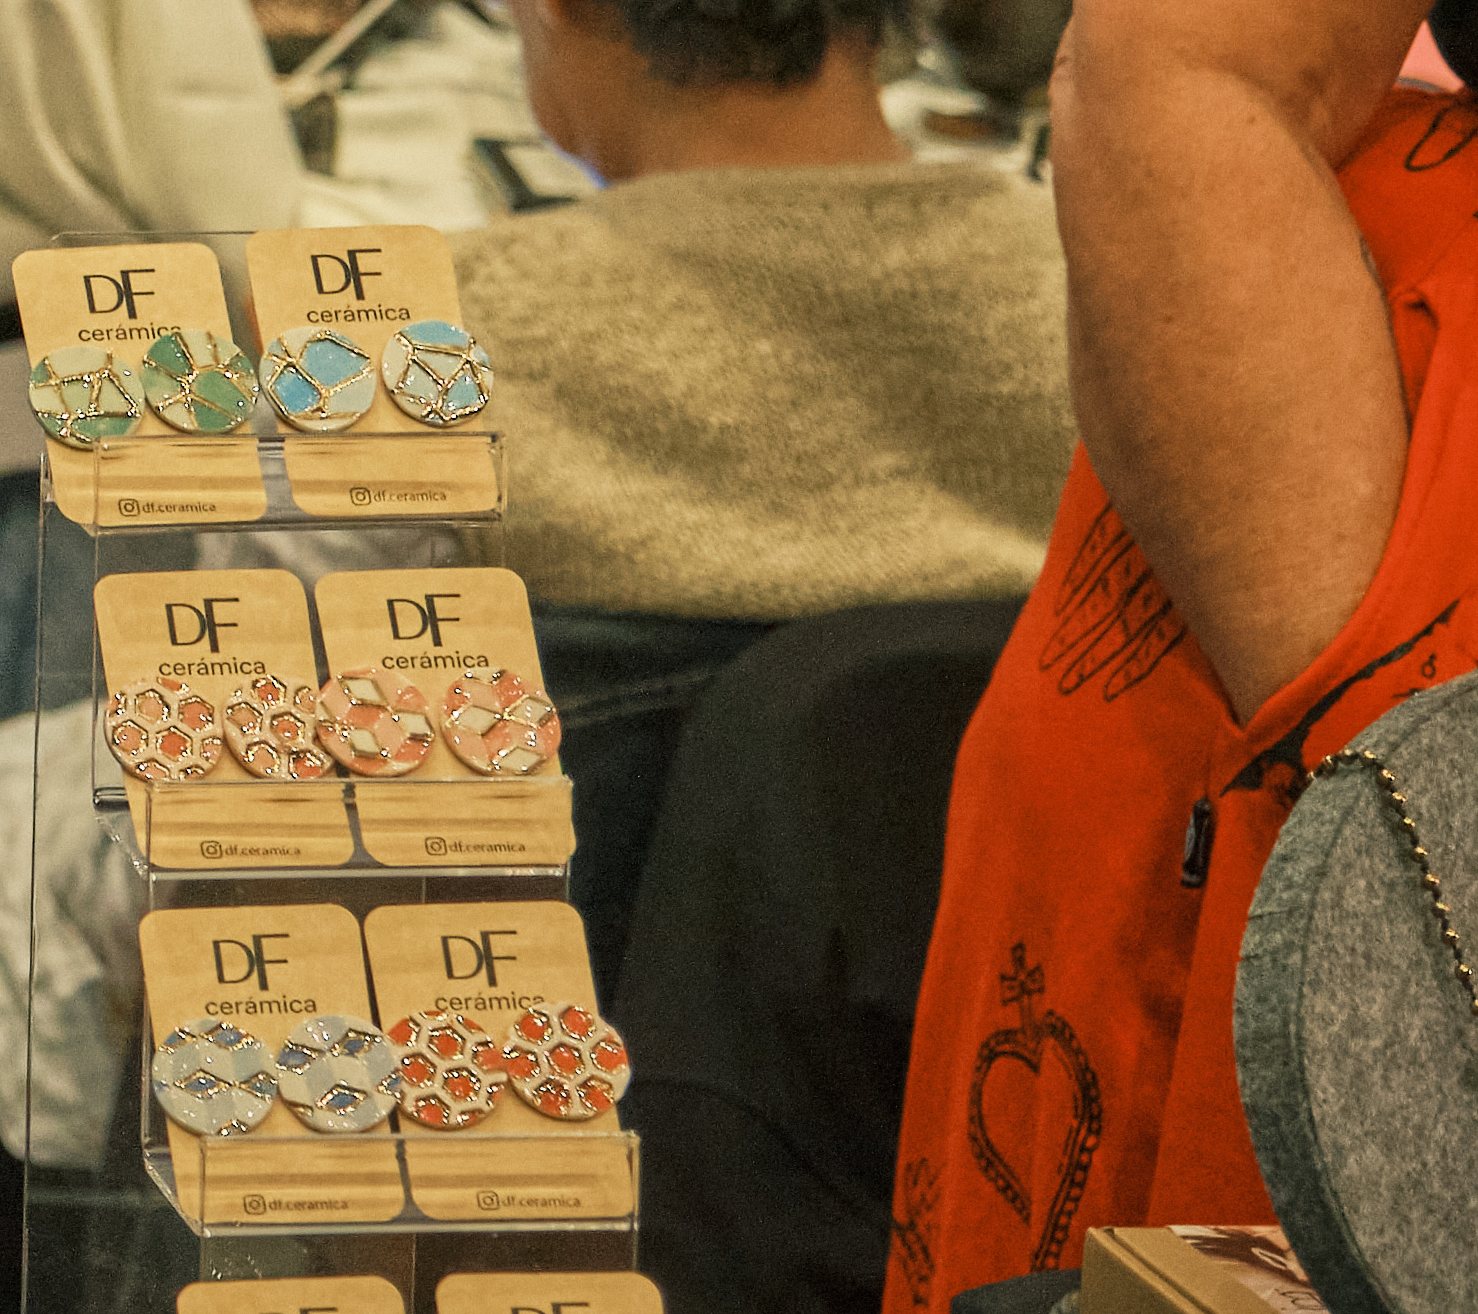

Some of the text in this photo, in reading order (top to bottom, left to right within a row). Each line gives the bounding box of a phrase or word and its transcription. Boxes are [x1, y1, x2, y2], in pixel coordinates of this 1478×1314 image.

[83, 268, 156, 319] DF
[310, 248, 382, 300] DF
[306, 304, 411, 325] cerámica
[165, 597, 239, 653] DF
[386, 593, 461, 647] DF
[158, 657, 266, 677] cerámica
[381, 651, 490, 670] cerámica
[212, 933, 290, 991] DF
[440, 929, 517, 987] DF
[205, 995, 317, 1016] cerámica
